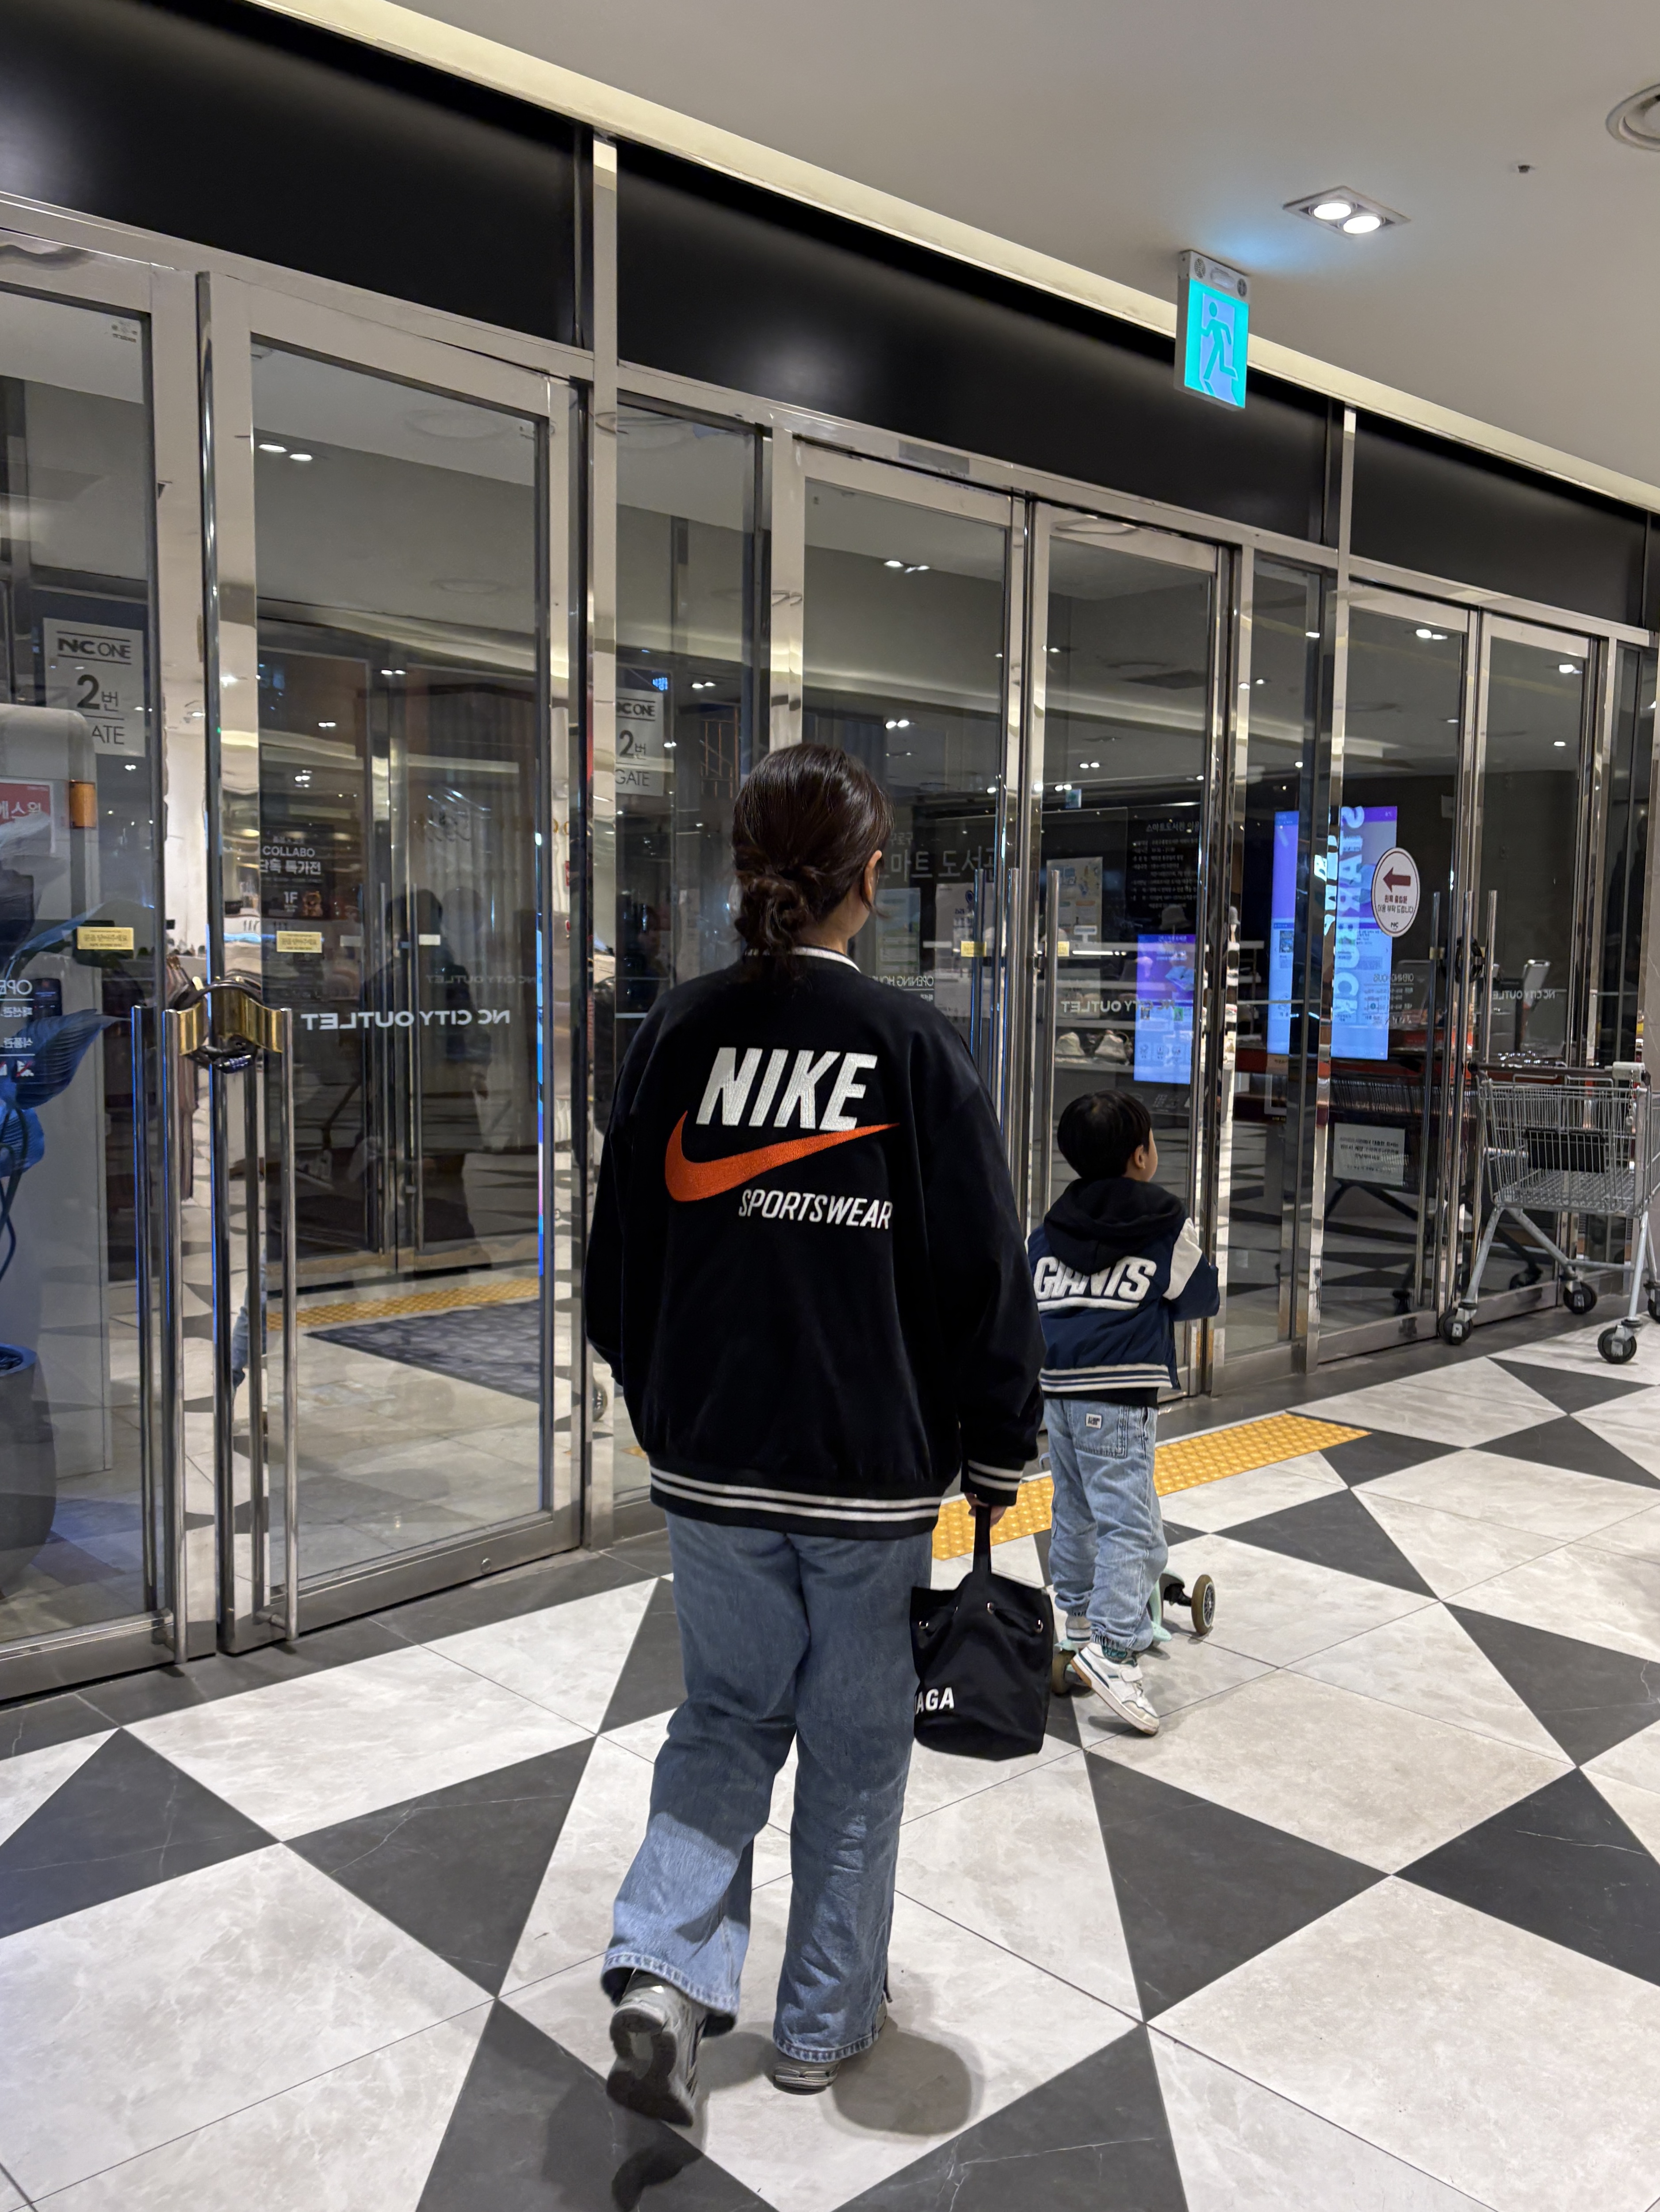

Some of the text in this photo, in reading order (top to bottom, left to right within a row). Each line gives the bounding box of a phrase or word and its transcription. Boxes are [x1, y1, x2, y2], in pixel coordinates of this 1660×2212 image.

[57, 638, 131, 659] NC ONE
[77, 674, 119, 711] 2번
[633, 703, 655, 717] ONE
[92, 725, 125, 745] ATE
[619, 730, 646, 760] 2번
[615, 769, 650, 787] GATE
[262, 846, 315, 858] COLLABO
[285, 860, 321, 875] 특가전
[879, 849, 933, 882] 마트
[283, 891, 298, 903] 1F
[696, 1047, 877, 1131] NIKE
[738, 1189, 893, 1230] SPORTSWEAR
[914, 1687, 954, 1715] AGA
